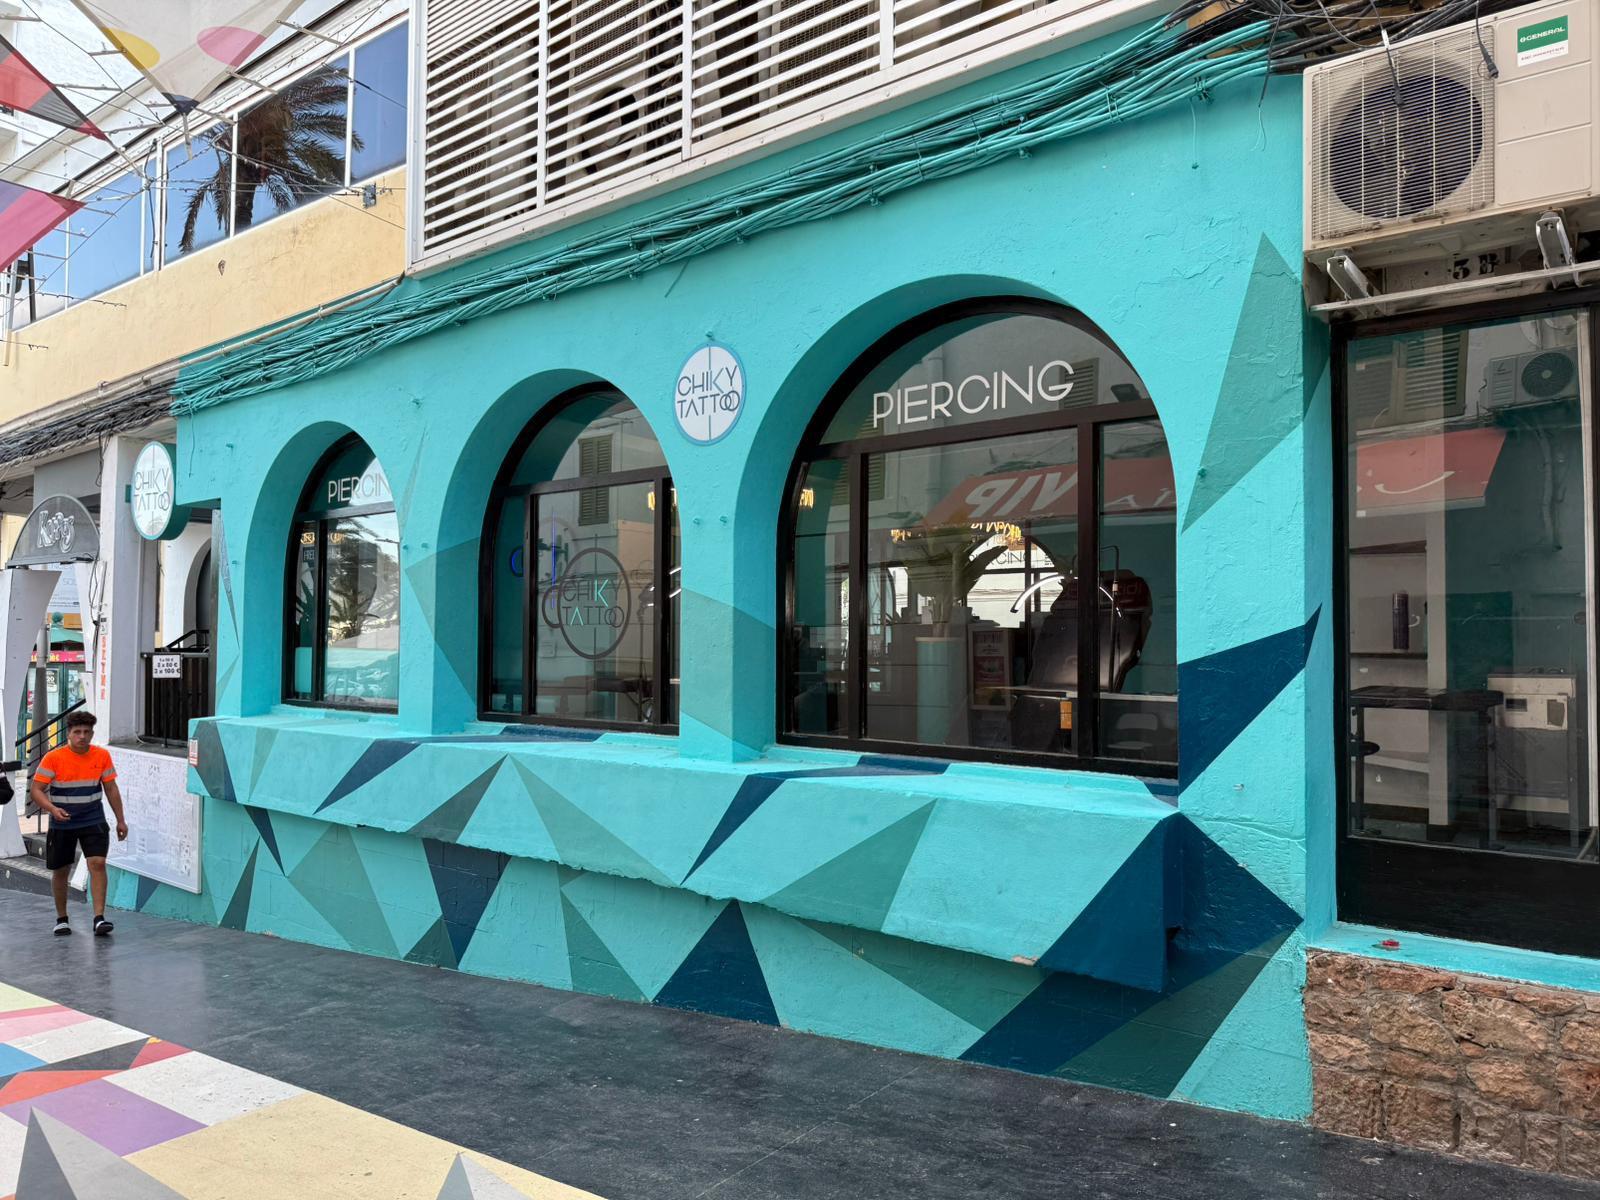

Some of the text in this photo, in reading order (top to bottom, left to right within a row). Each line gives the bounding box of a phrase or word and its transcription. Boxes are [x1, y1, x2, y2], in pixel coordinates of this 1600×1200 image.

[677, 365, 738, 396] CHIKY
[873, 359, 1074, 428] PIERCING
[677, 390, 741, 419] TATTOO
[134, 467, 170, 492] CHIKY
[328, 473, 391, 503] PIERCIN
[562, 577, 623, 608] CHIKY
